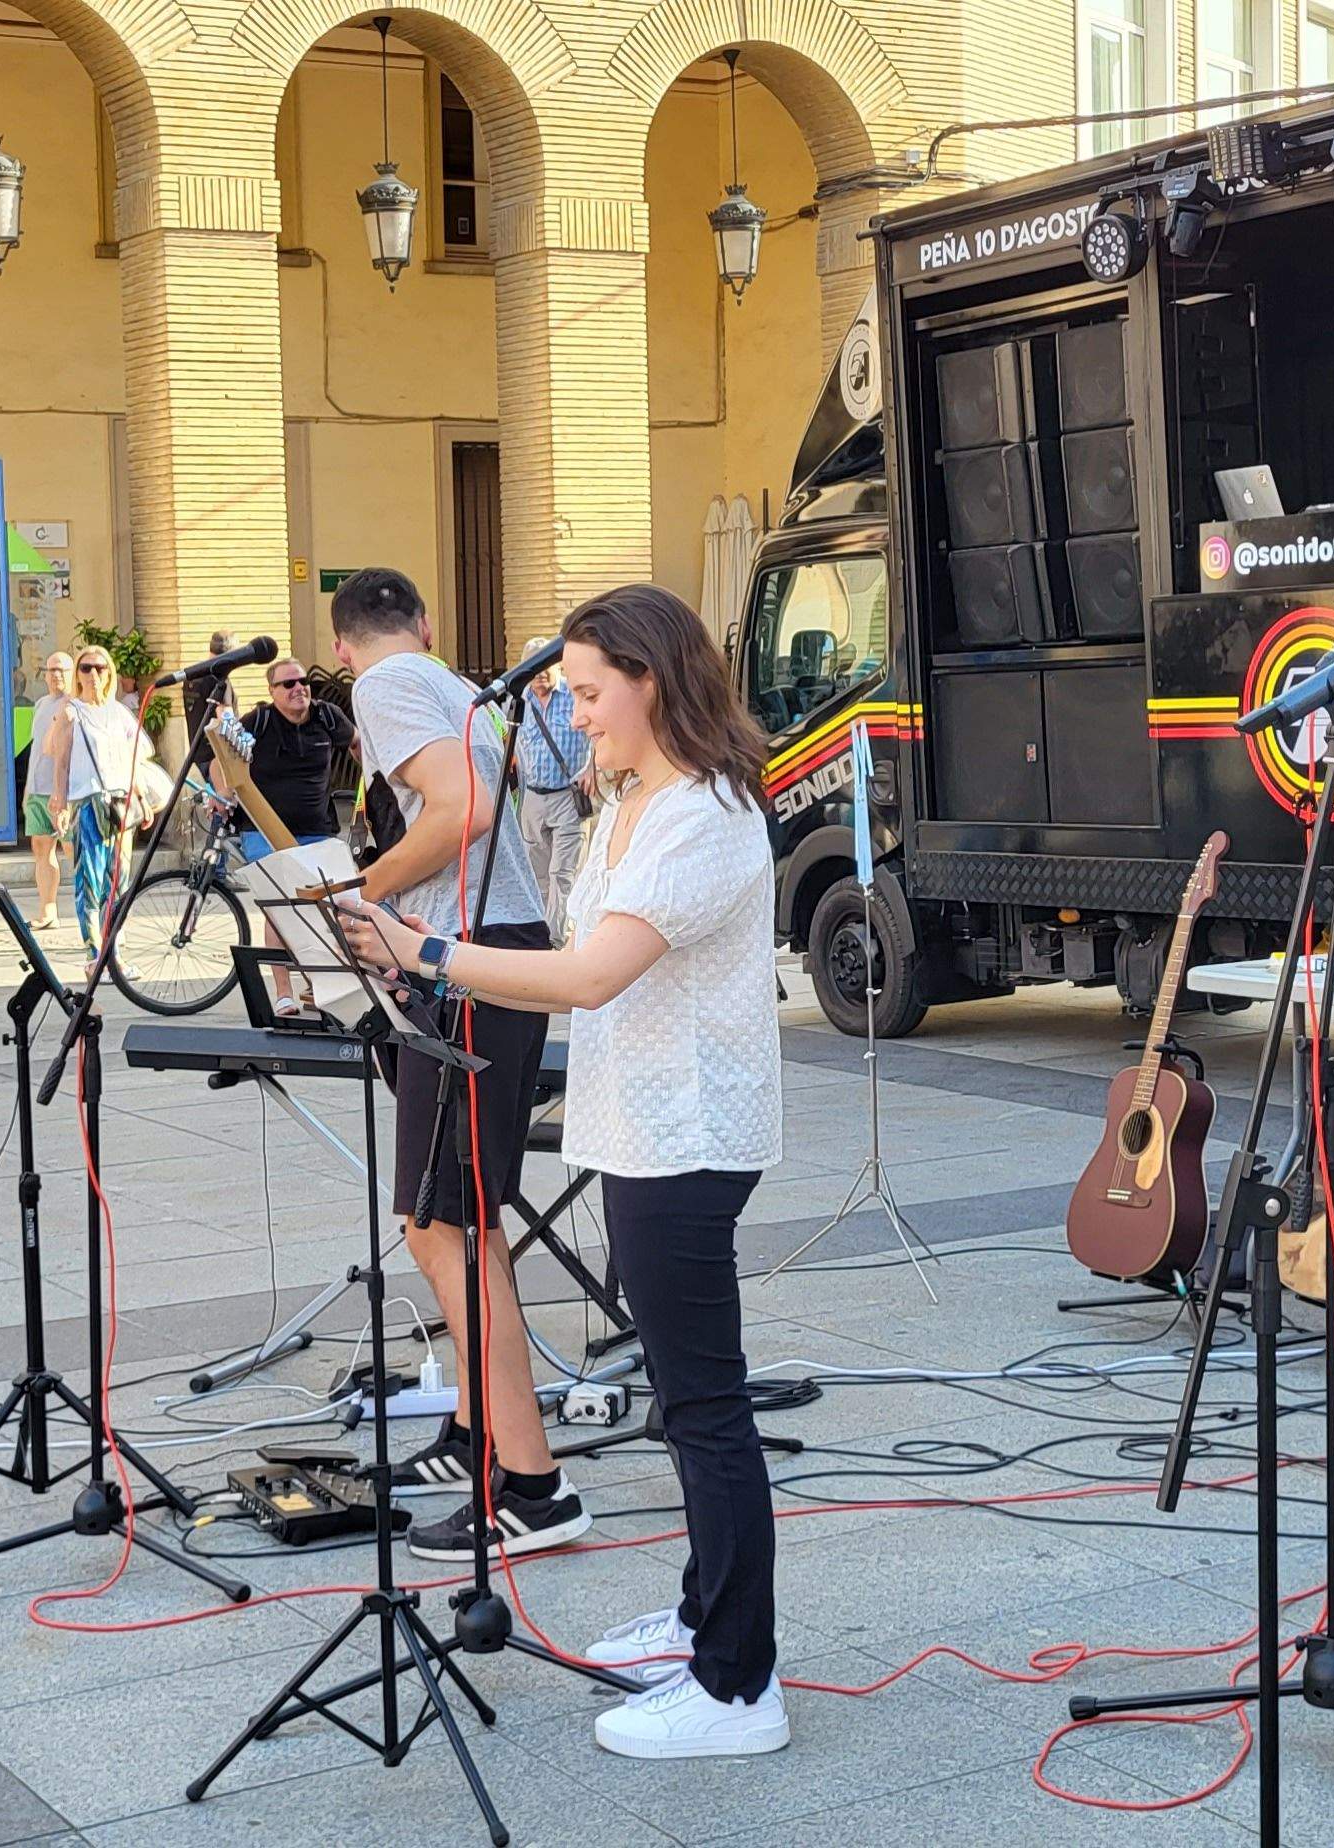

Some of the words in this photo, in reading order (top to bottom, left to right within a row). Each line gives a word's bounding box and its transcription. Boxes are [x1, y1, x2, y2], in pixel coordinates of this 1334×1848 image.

[920, 232, 971, 271] PEÑA
[974, 228, 996, 258] 10
[774, 751, 856, 825] SONIDO
